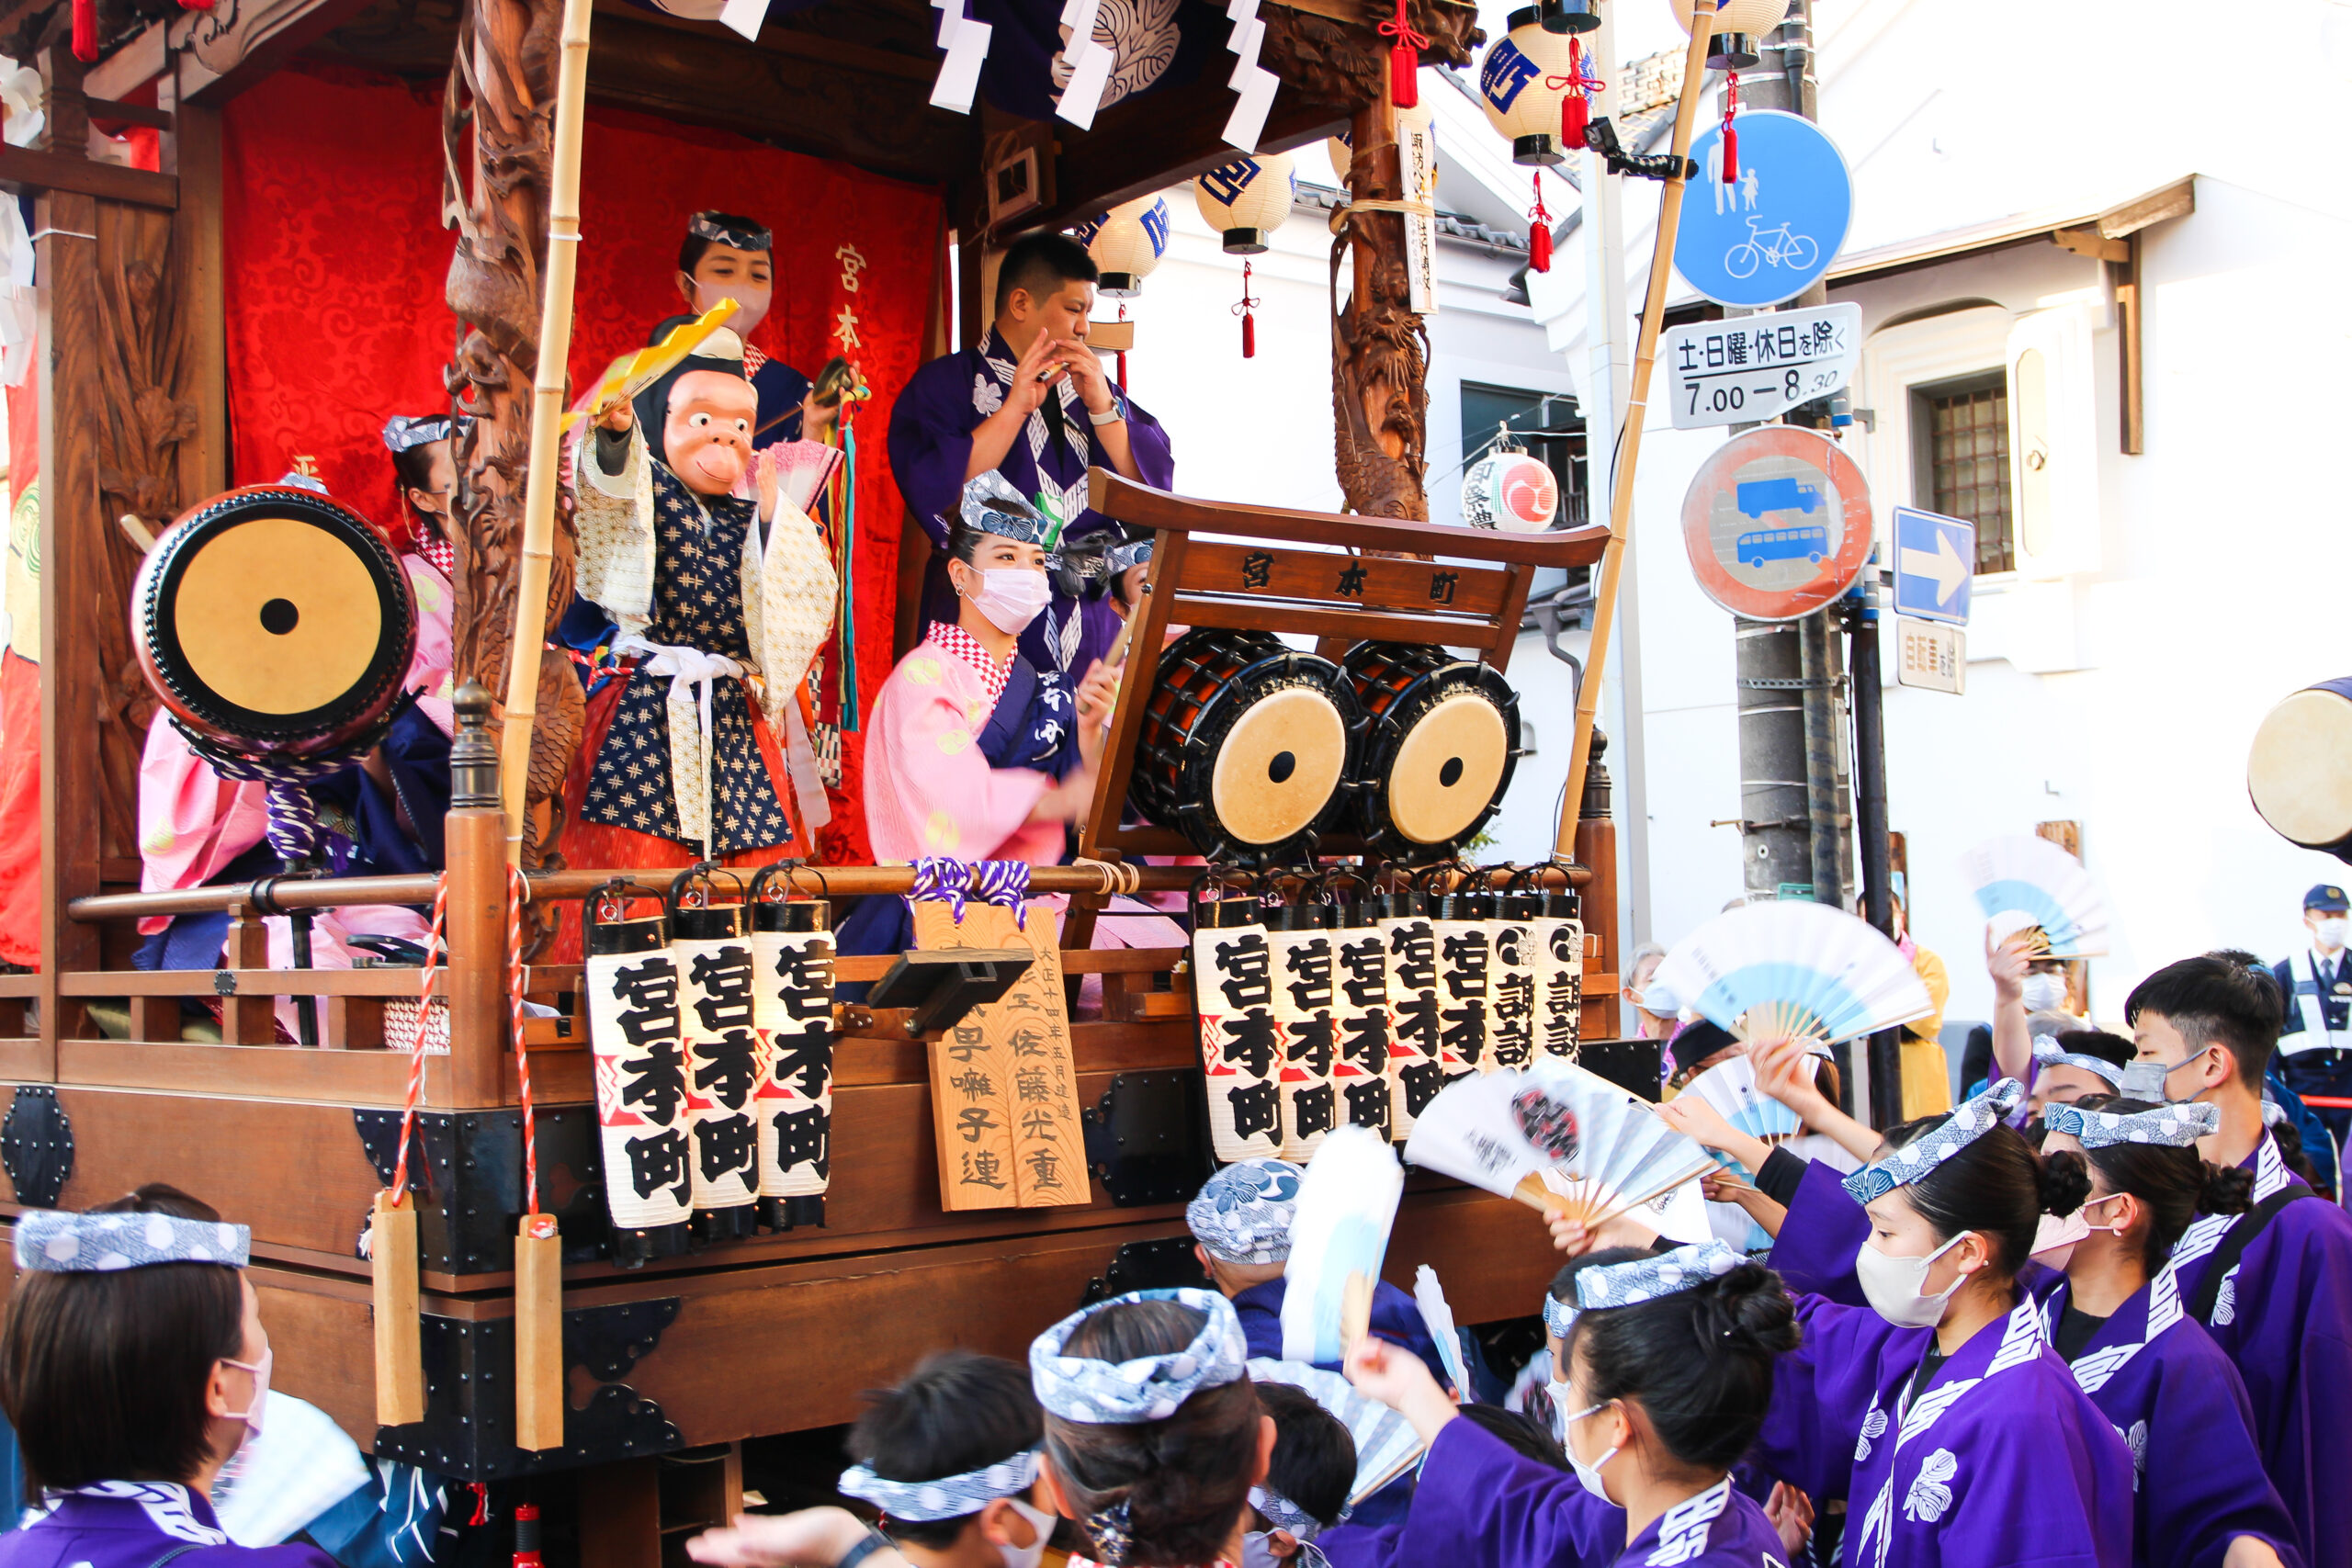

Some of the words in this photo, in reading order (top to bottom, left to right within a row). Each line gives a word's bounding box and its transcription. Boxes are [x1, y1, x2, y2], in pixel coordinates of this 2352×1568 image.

[1679, 321, 1846, 371] 土・日曜・休日を除く
[1242, 551, 1460, 606] 宮本町
[613, 957, 692, 1208] 宮本町
[690, 945, 760, 1194] 宮本町
[773, 939, 834, 1181] 宮本町
[1216, 934, 1283, 1147] 宮本町
[1286, 938, 1337, 1140] 宮本町
[1340, 937, 1392, 1144] 宮本町
[1441, 931, 1489, 1086] 宮本
[1492, 972, 1535, 1075] 諏訪
